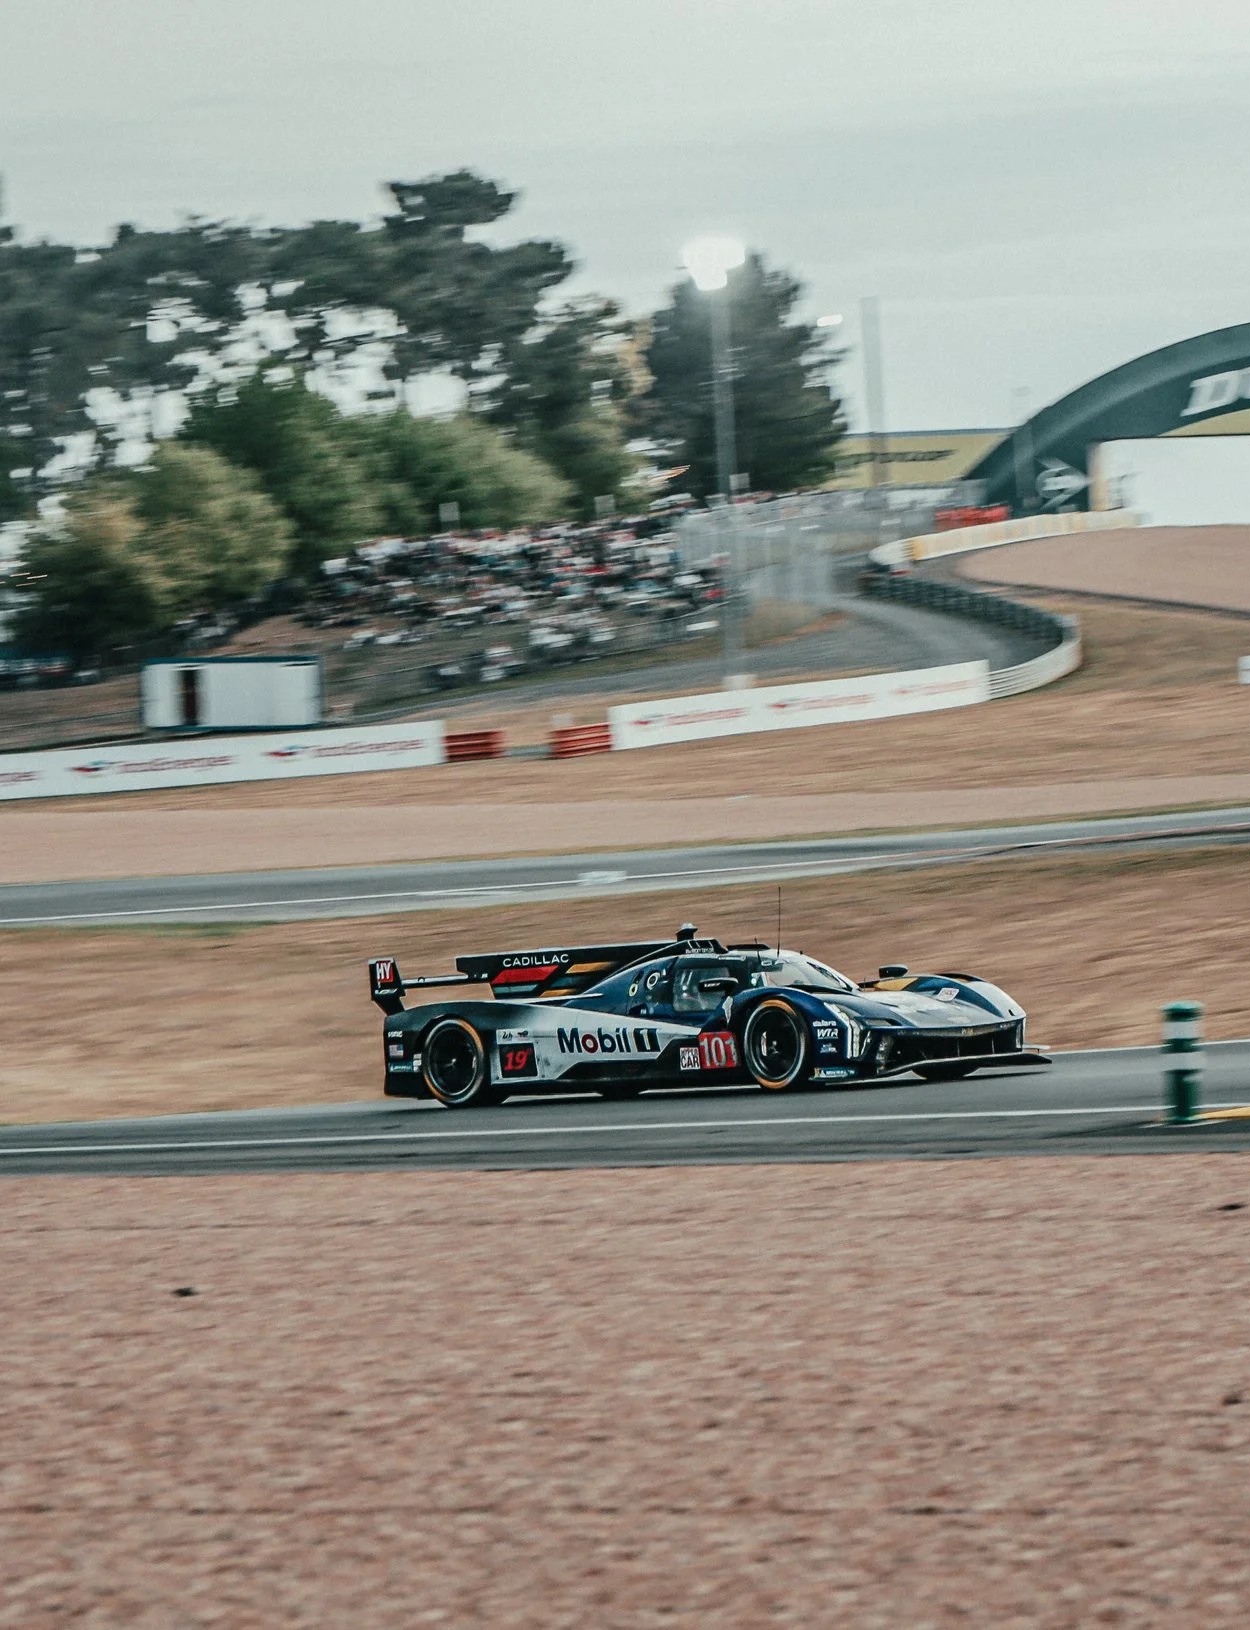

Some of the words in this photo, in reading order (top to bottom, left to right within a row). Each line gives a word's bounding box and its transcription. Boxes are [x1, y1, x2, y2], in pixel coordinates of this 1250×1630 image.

[503, 953, 569, 968] CADILLAC
[376, 962, 391, 980] HY
[557, 1027, 631, 1054] Mobil
[699, 1036, 738, 1067] 101
[681, 1055, 699, 1068] CAR
